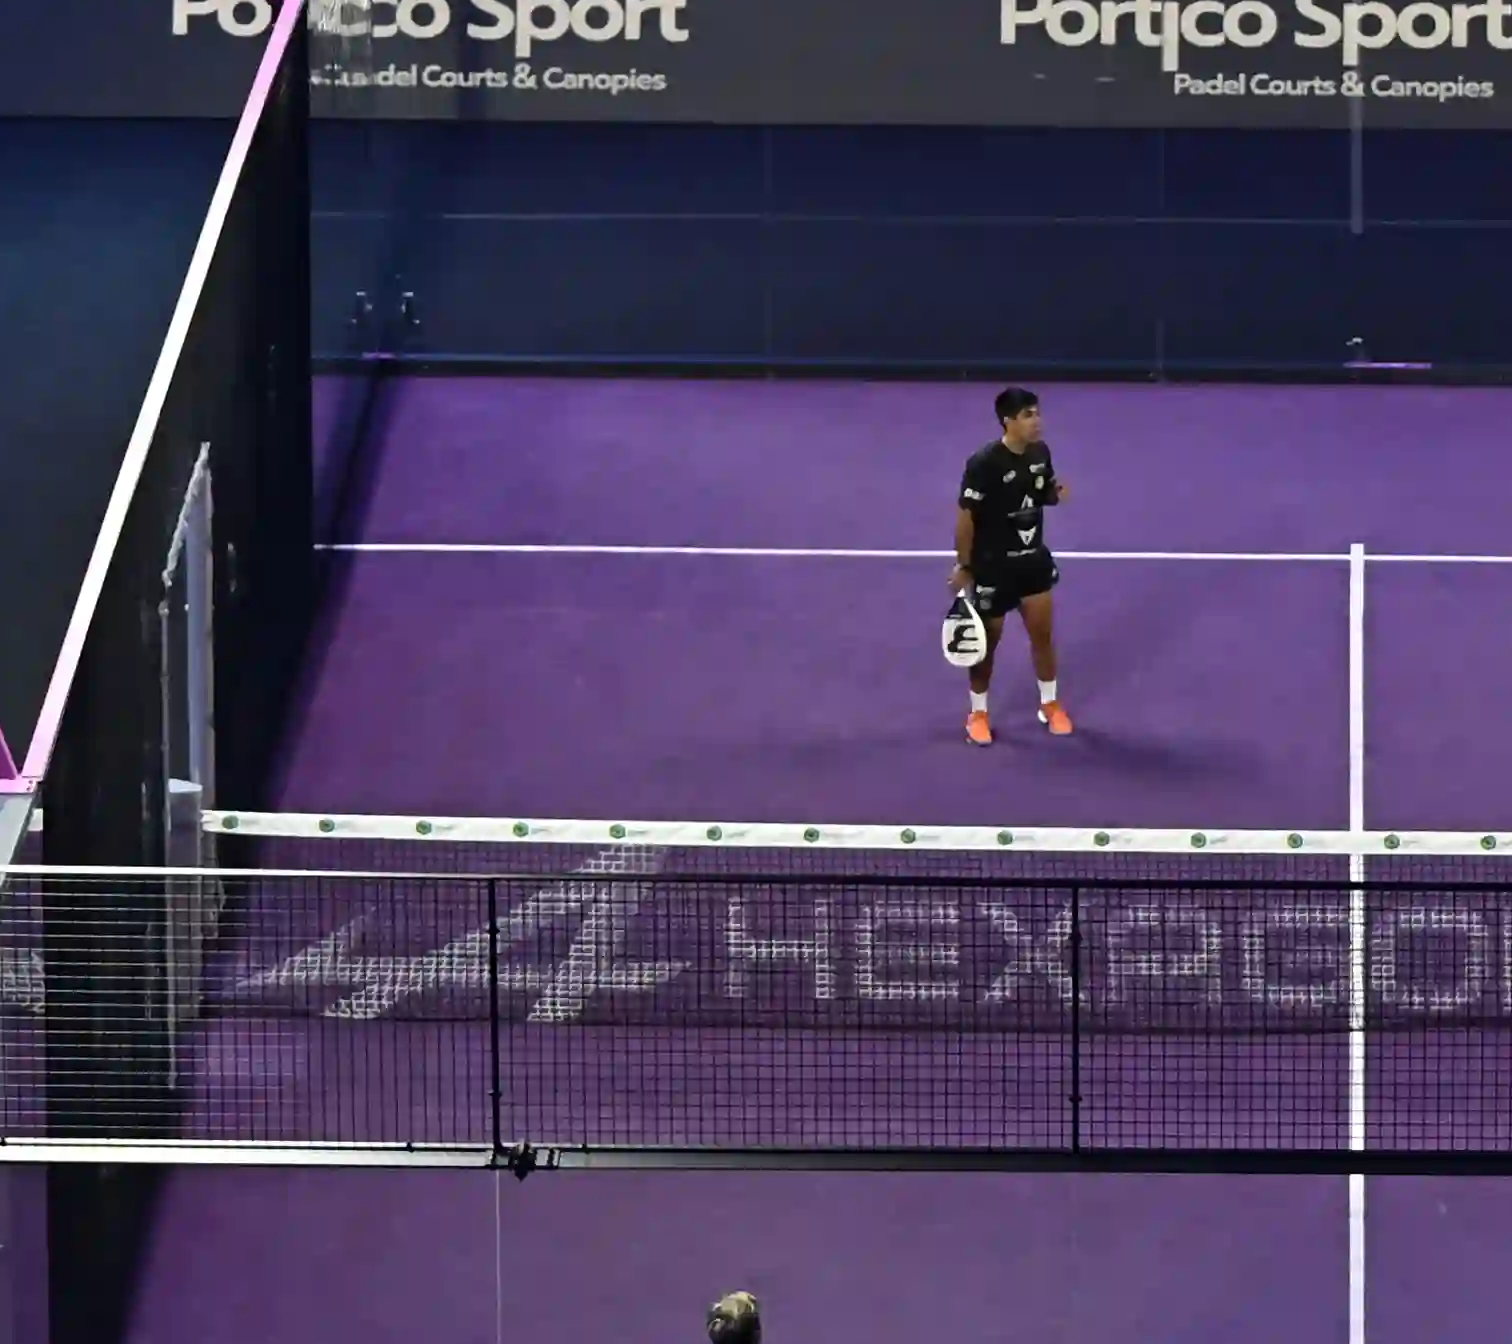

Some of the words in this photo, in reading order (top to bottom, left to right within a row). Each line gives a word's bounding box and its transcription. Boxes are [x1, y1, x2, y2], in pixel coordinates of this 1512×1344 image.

[423, 66, 507, 89] Courts
[513, 64, 538, 90] &
[542, 67, 667, 95] Canopies
[1174, 73, 1246, 96] Padel
[1249, 73, 1336, 97] Courts
[1340, 72, 1366, 98] &
[1370, 74, 1494, 102] Canopies
